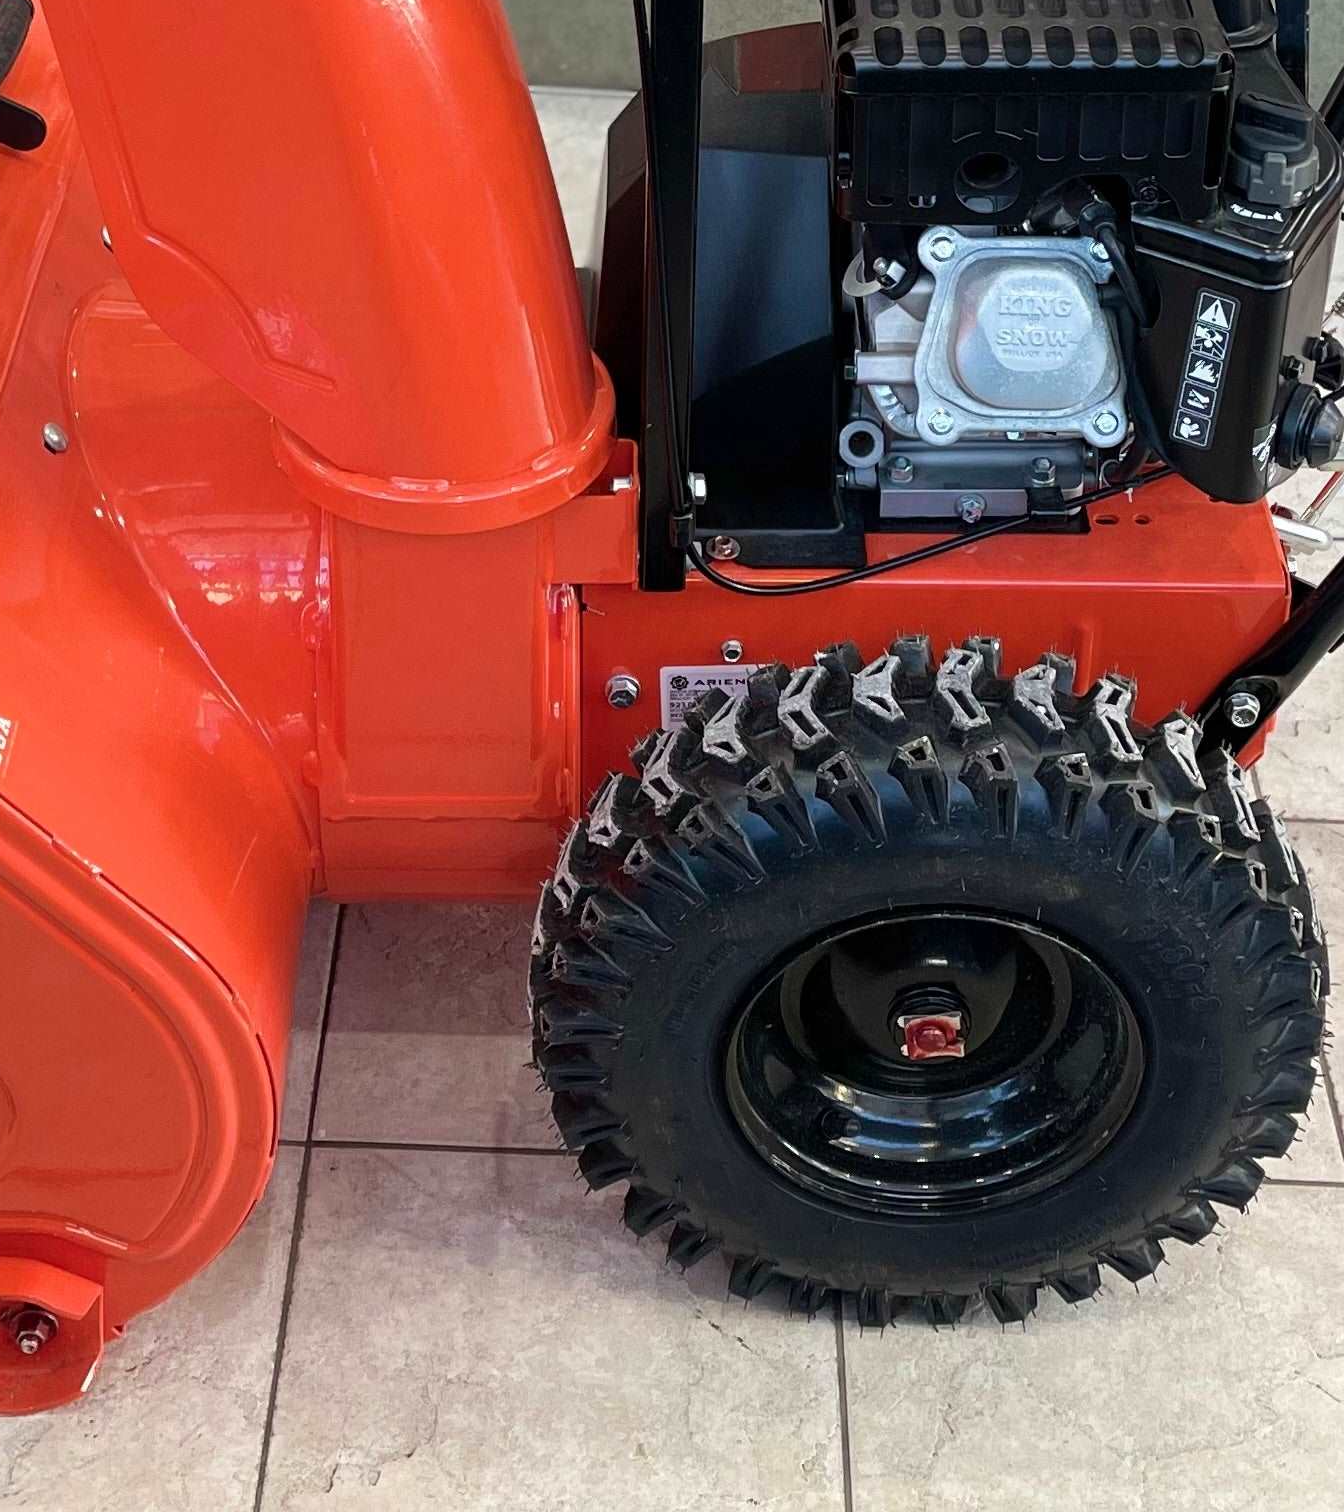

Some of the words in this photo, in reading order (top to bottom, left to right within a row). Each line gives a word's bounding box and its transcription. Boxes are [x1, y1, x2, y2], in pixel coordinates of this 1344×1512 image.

[998, 295, 1073, 317] KING
[997, 328, 1072, 347] SNOW
[694, 678, 746, 686] ARIEN
